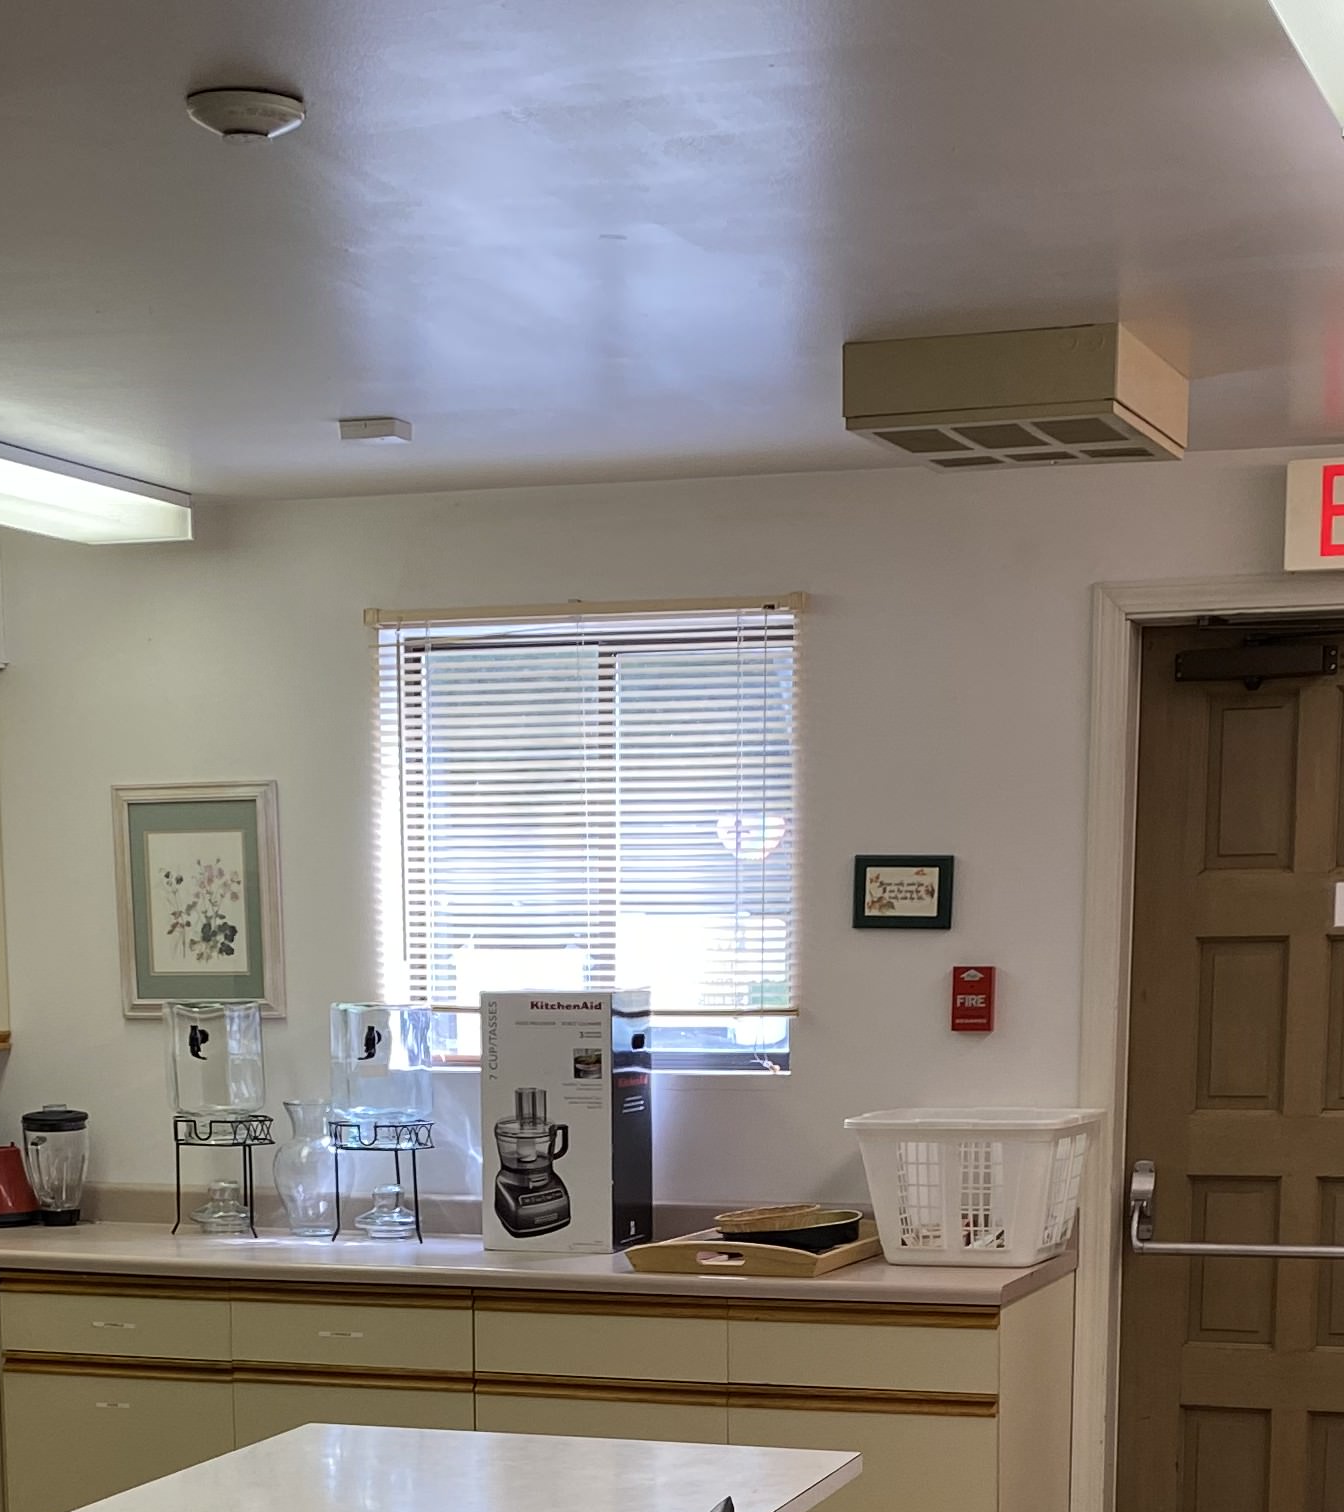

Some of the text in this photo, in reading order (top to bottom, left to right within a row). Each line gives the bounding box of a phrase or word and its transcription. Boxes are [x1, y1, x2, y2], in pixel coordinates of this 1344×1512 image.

[529, 1000, 603, 1011] KitchenAid
[956, 994, 987, 1008] FIRE
[488, 1000, 499, 1071] CUP/TASSES
